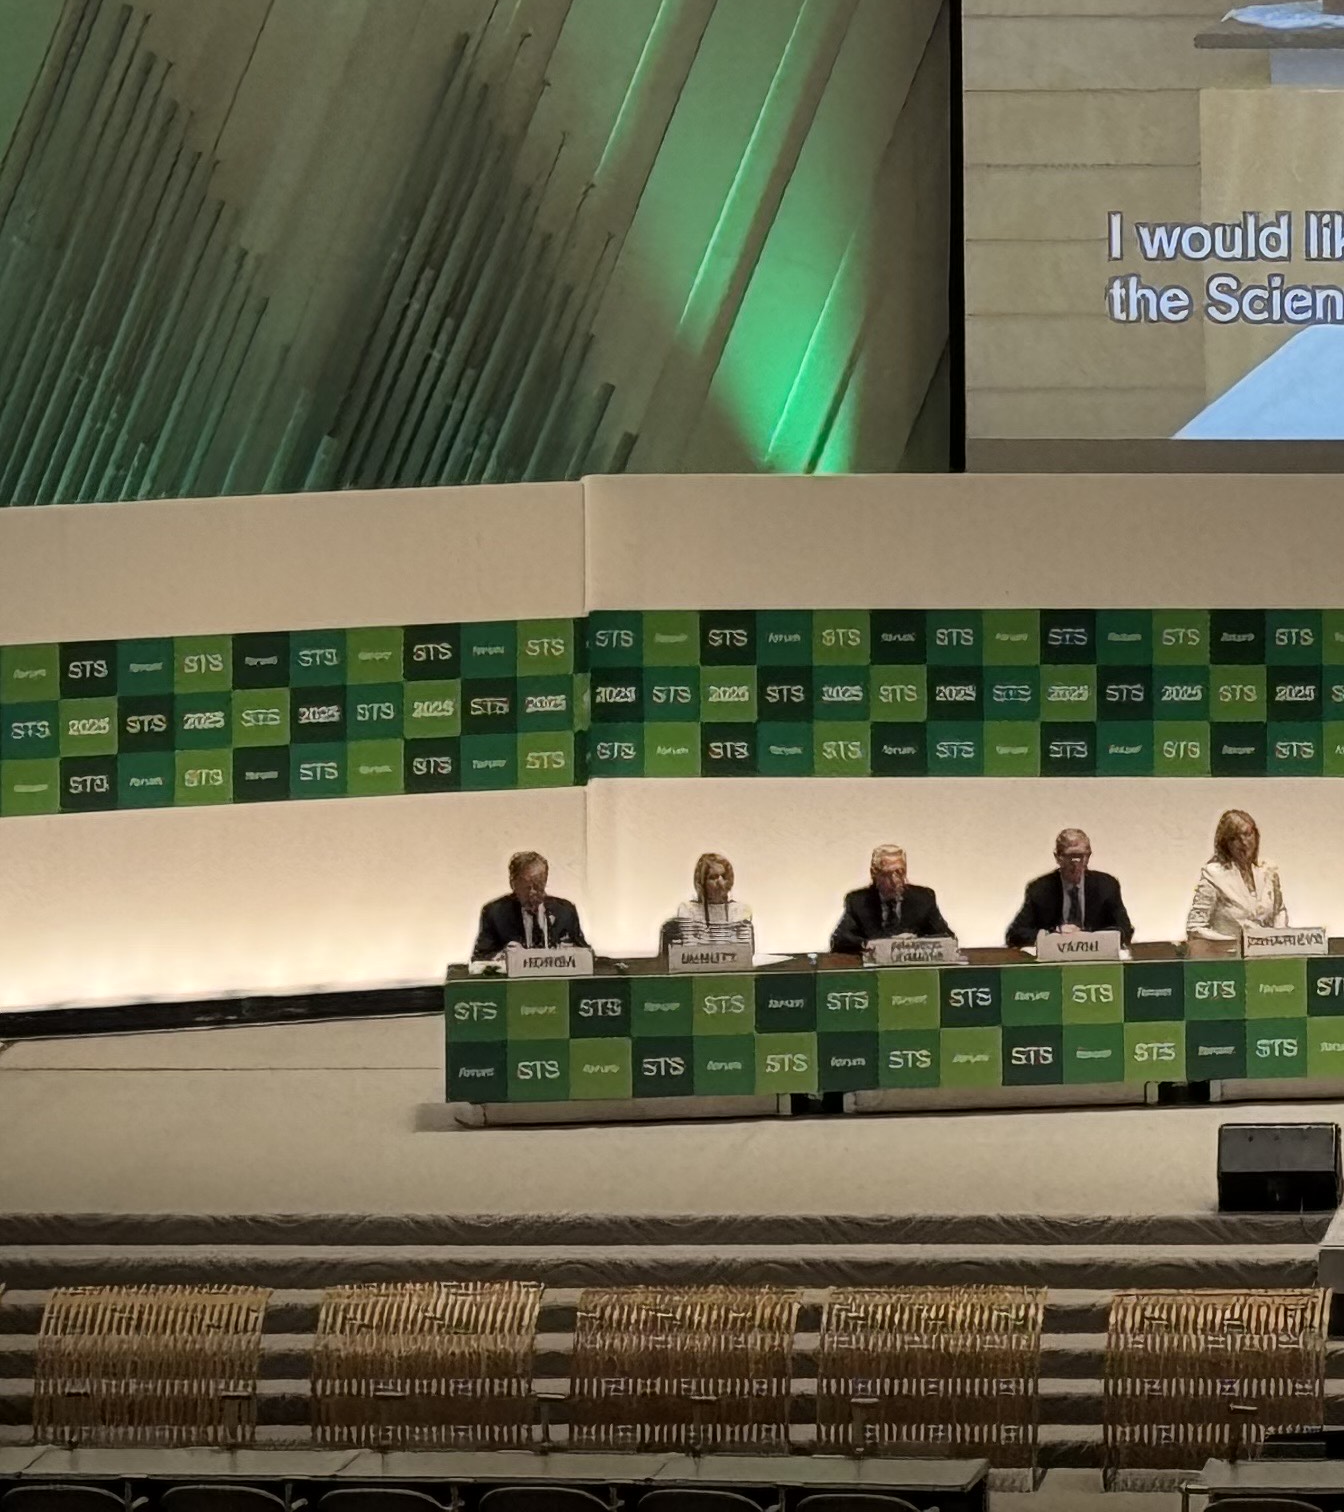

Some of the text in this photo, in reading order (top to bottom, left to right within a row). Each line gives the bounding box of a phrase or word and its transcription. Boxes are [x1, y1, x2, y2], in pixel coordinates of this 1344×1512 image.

[1109, 213, 1121, 259] I
[1139, 213, 1290, 259] would
[1109, 276, 1189, 322] the
[525, 637, 565, 656] STS
[595, 629, 634, 648] STS
[708, 629, 748, 647] STS
[821, 628, 861, 647] STS
[935, 628, 974, 646] STS
[1162, 627, 1201, 646] STS
[412, 642, 453, 662] STS
[68, 659, 109, 679] STS
[184, 653, 224, 674] STS
[652, 685, 692, 704] STS
[765, 684, 805, 703] STS
[878, 684, 918, 703] STS
[1105, 683, 1145, 702] STS
[1218, 684, 1258, 702] STS
[356, 702, 395, 721] STS
[11, 720, 51, 740] STS
[126, 713, 167, 734] STS
[525, 750, 566, 769] STS
[709, 741, 750, 759] STS
[935, 741, 975, 759] STS
[1275, 741, 1315, 759] STS
[412, 756, 452, 775] STS
[950, 987, 992, 1008] STS
[1071, 983, 1114, 1003] STS
[1194, 980, 1236, 1000] STS
[578, 998, 622, 1017] STS
[702, 994, 745, 1015] STS
[826, 990, 869, 1011] STS
[454, 1001, 498, 1022] STS
[1011, 1046, 1053, 1066] STS
[1133, 1042, 1176, 1062] STS
[1255, 1038, 1298, 1058] STS
[642, 1056, 685, 1076] STS
[765, 1053, 808, 1073] STS
[888, 1049, 931, 1069] STS
[517, 1060, 561, 1080] STS
